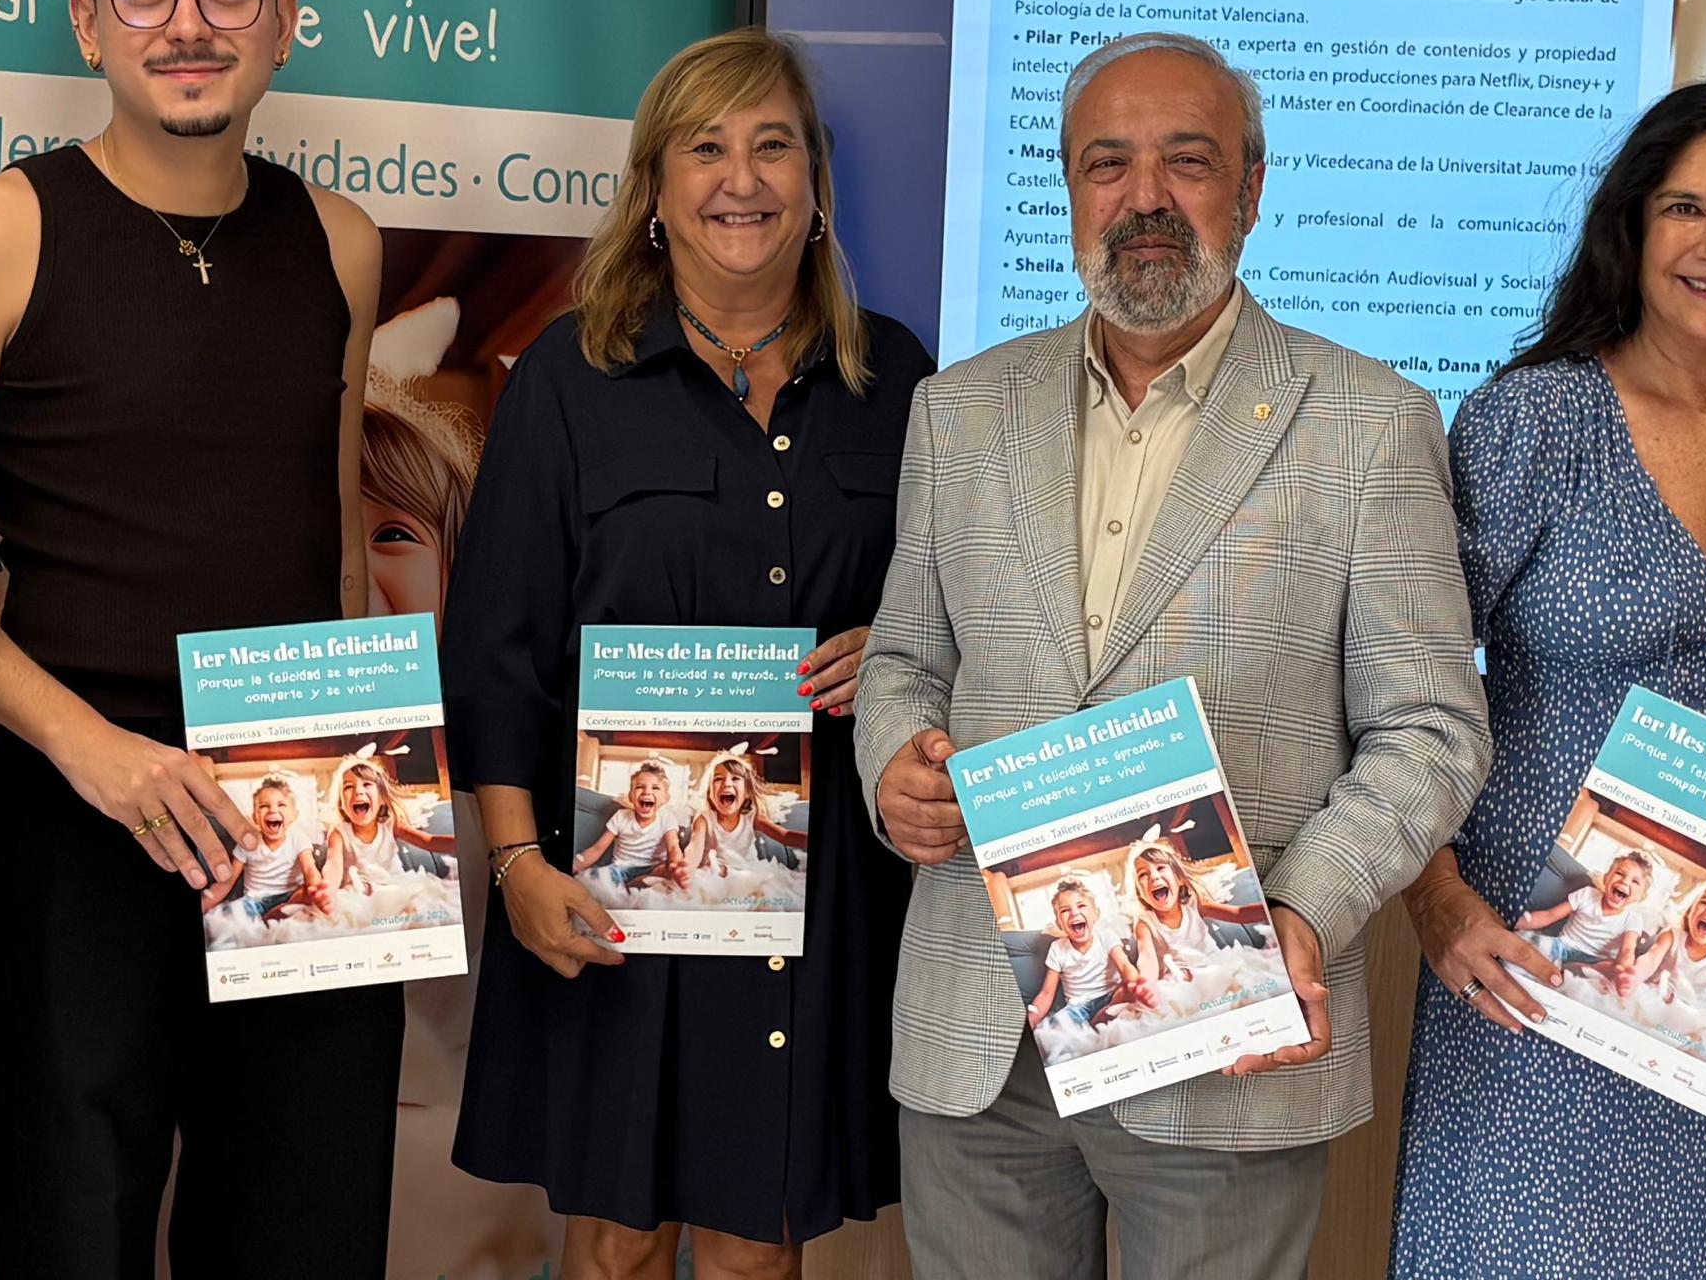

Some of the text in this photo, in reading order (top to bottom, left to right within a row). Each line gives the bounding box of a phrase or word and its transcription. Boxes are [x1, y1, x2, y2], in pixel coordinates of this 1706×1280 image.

[1015, 0, 1309, 24] Psicología de la Comunitat Valenciana.
[363, 0, 499, 64] vive!
[1237, 39, 1617, 64] experta en gestión de contenidos y propiedad
[228, 646, 271, 666] Mes
[273, 642, 300, 662] de
[302, 639, 324, 660] la
[326, 629, 419, 657] felicidad
[626, 642, 665, 660] Mes
[667, 642, 691, 660] de
[694, 642, 712, 660] la
[716, 642, 799, 661] felicidad
[995, 752, 1038, 776] Mes
[1038, 740, 1065, 762] de
[1064, 733, 1088, 753] la
[1087, 698, 1179, 746] felicidad
[1663, 721, 1706, 754] Mes
